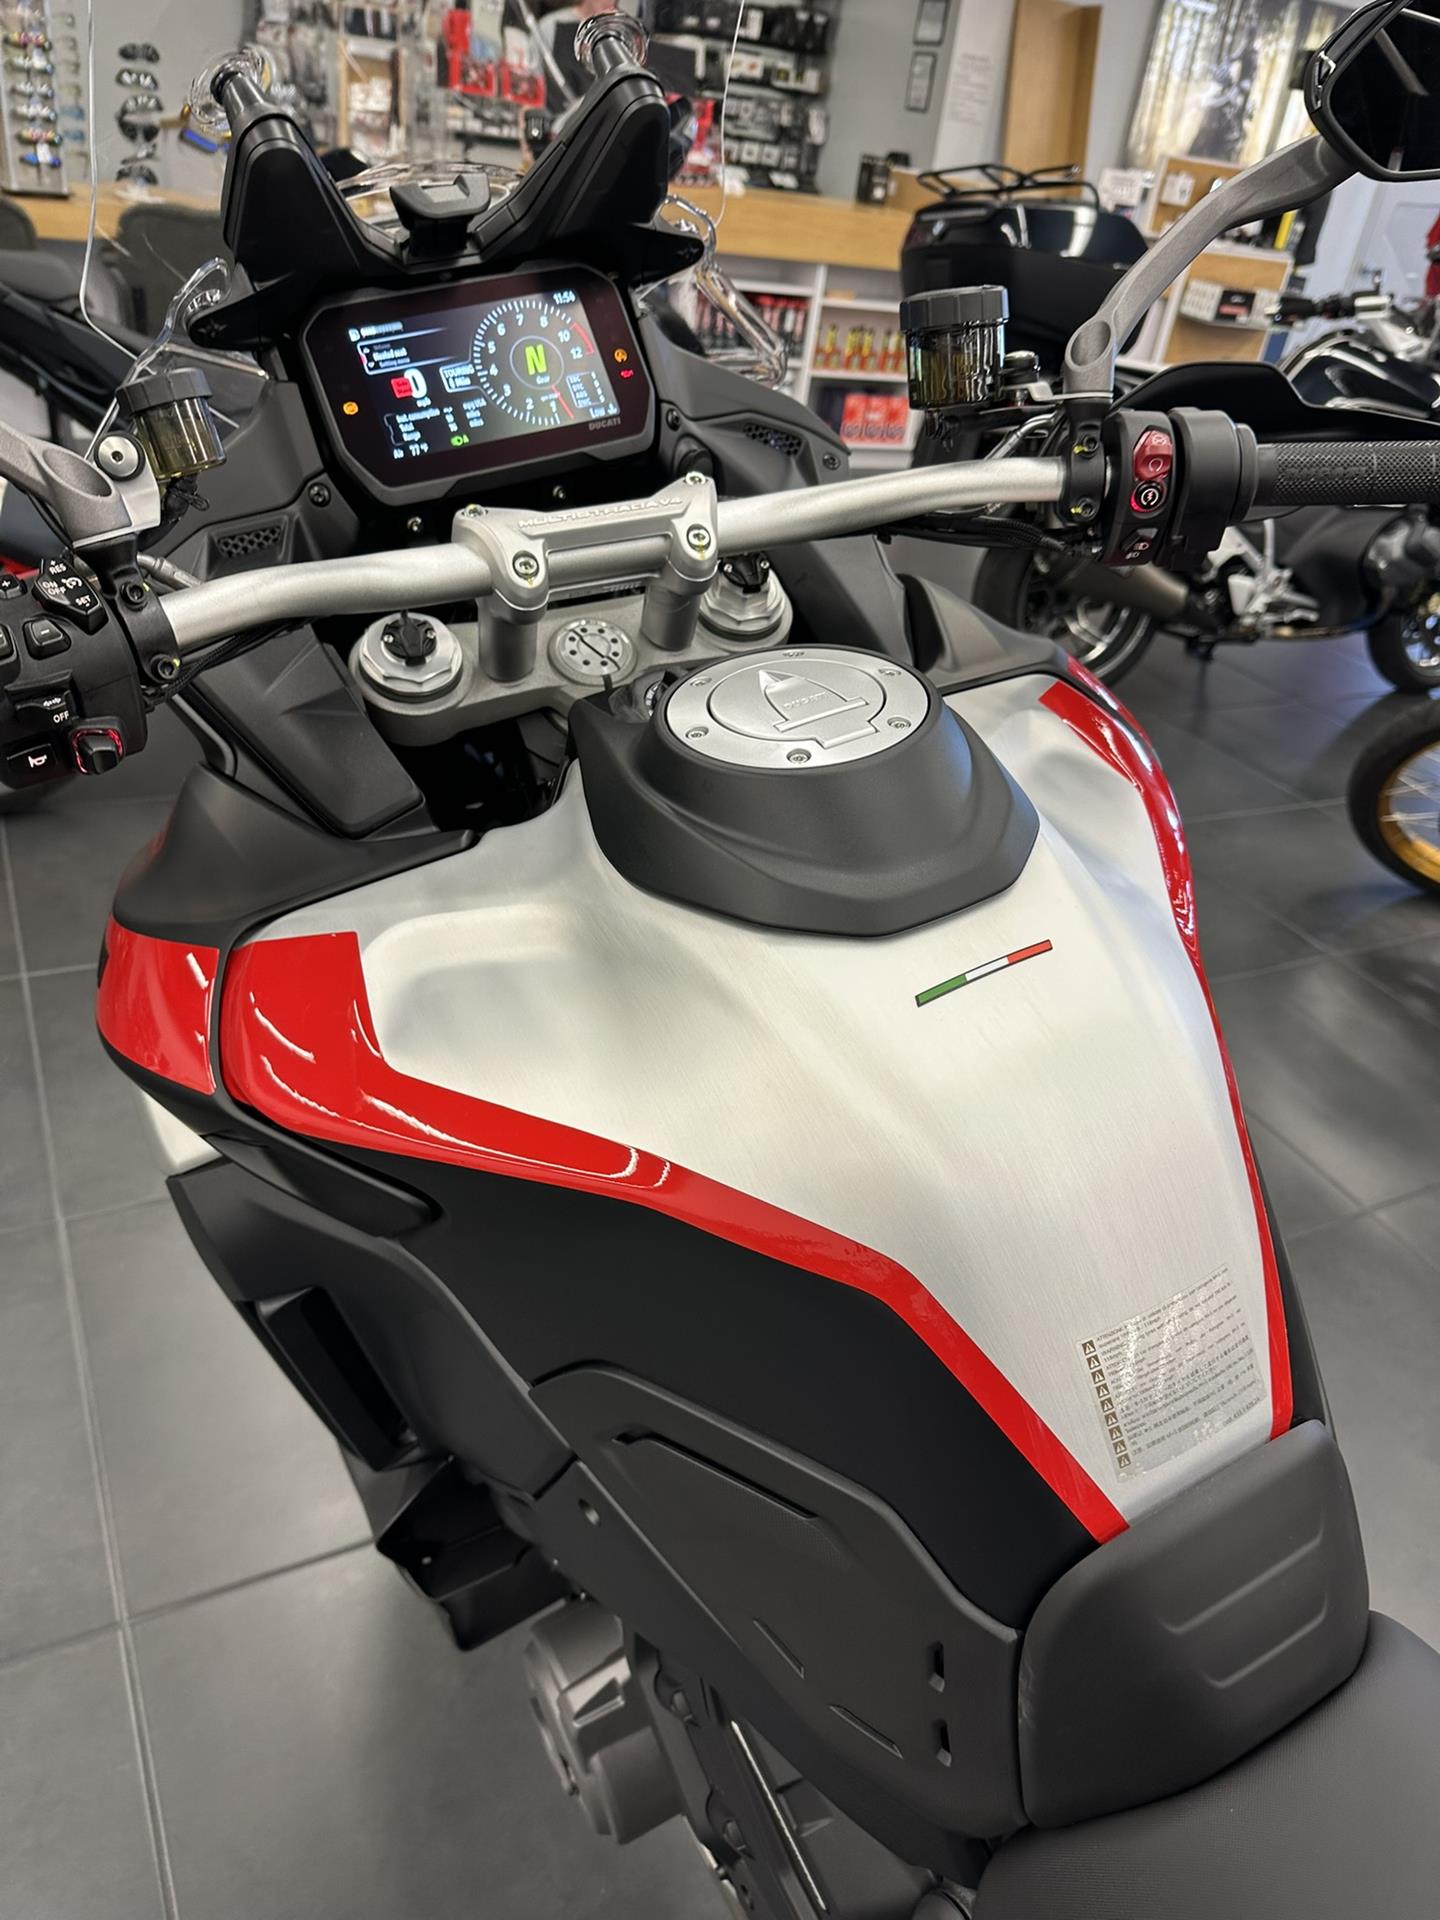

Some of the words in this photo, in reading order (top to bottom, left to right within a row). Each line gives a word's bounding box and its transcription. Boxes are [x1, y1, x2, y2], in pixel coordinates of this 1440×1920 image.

[516, 313, 524, 327] 7
[540, 315, 548, 329] 8
[497, 322, 506, 336] 6
[558, 329, 571, 343] 10
[488, 341, 496, 354] 5
[570, 346, 583, 360] 12
[525, 344, 547, 376] N
[489, 363, 498, 376] 4
[404, 368, 427, 399] 0
[503, 384, 511, 397] 3
[525, 397, 534, 410] 2
[550, 400, 557, 413] 1
[589, 417, 621, 430] DUCATI
[49, 564, 67, 575] RES
[42, 580, 58, 590] ON
[48, 585, 67, 596] OFF
[75, 596, 91, 606] SET
[53, 710, 70, 724] OFF
